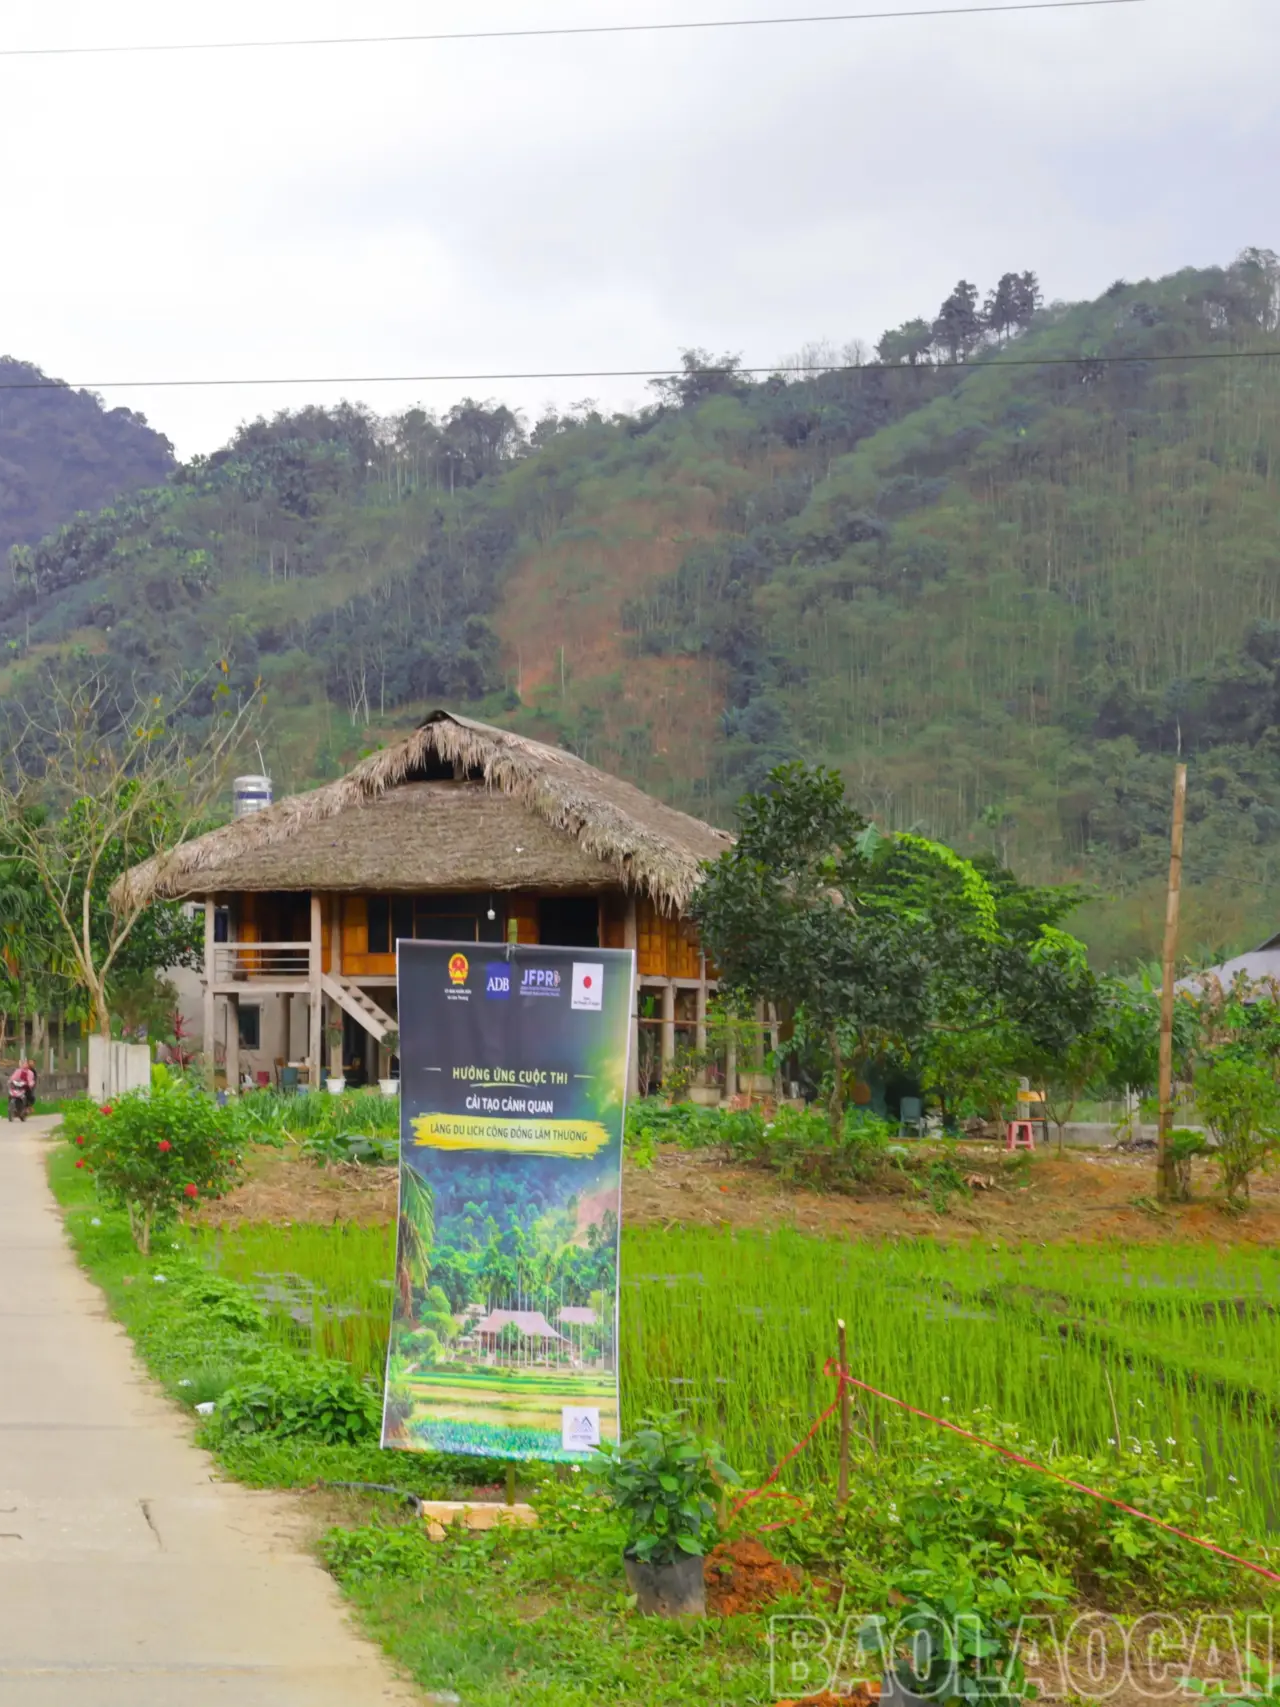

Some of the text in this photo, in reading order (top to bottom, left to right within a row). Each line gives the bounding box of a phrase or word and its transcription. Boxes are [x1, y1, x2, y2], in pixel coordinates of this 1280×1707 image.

[486, 977, 510, 992] ADB
[521, 969, 554, 987] JFPR
[493, 1066, 516, 1082] ỨNG
[519, 1068, 547, 1086] CUỘC
[550, 1071, 568, 1084] THI
[465, 1093, 554, 1114] CẢI TẠO CẢNH QUAN
[430, 1121, 451, 1135] LÀNG
[453, 1124, 466, 1135] DU
[486, 1124, 509, 1140] CỘNG
